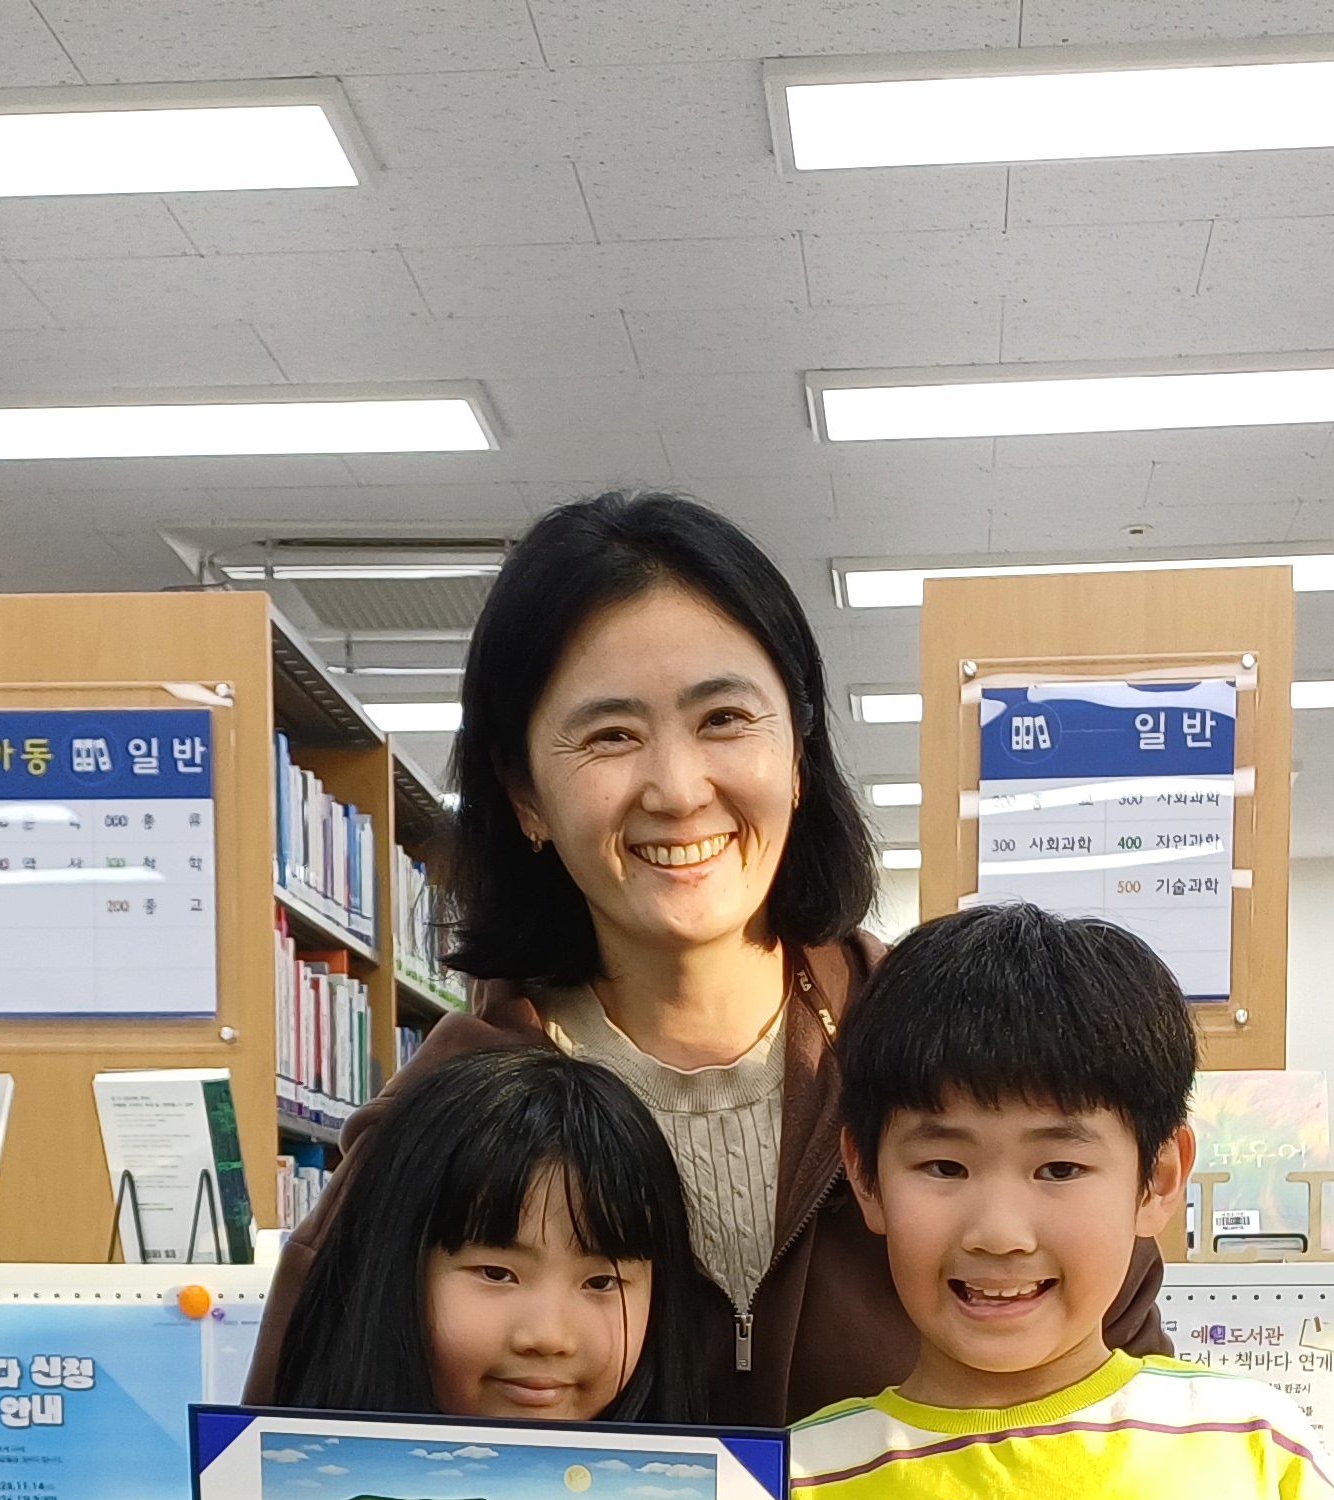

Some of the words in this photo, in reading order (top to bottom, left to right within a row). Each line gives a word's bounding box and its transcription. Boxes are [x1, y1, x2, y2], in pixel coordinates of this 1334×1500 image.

[127, 737, 208, 776] 일반
[992, 840, 1015, 851] 300
[1029, 835, 1092, 853] 사회과학
[1117, 836, 1142, 849] 400
[1118, 880, 1141, 894] 500
[1156, 878, 1219, 895] 기술과학
[1235, 1351, 1292, 1372] 책바다
[30, 1354, 96, 1391] 신청
